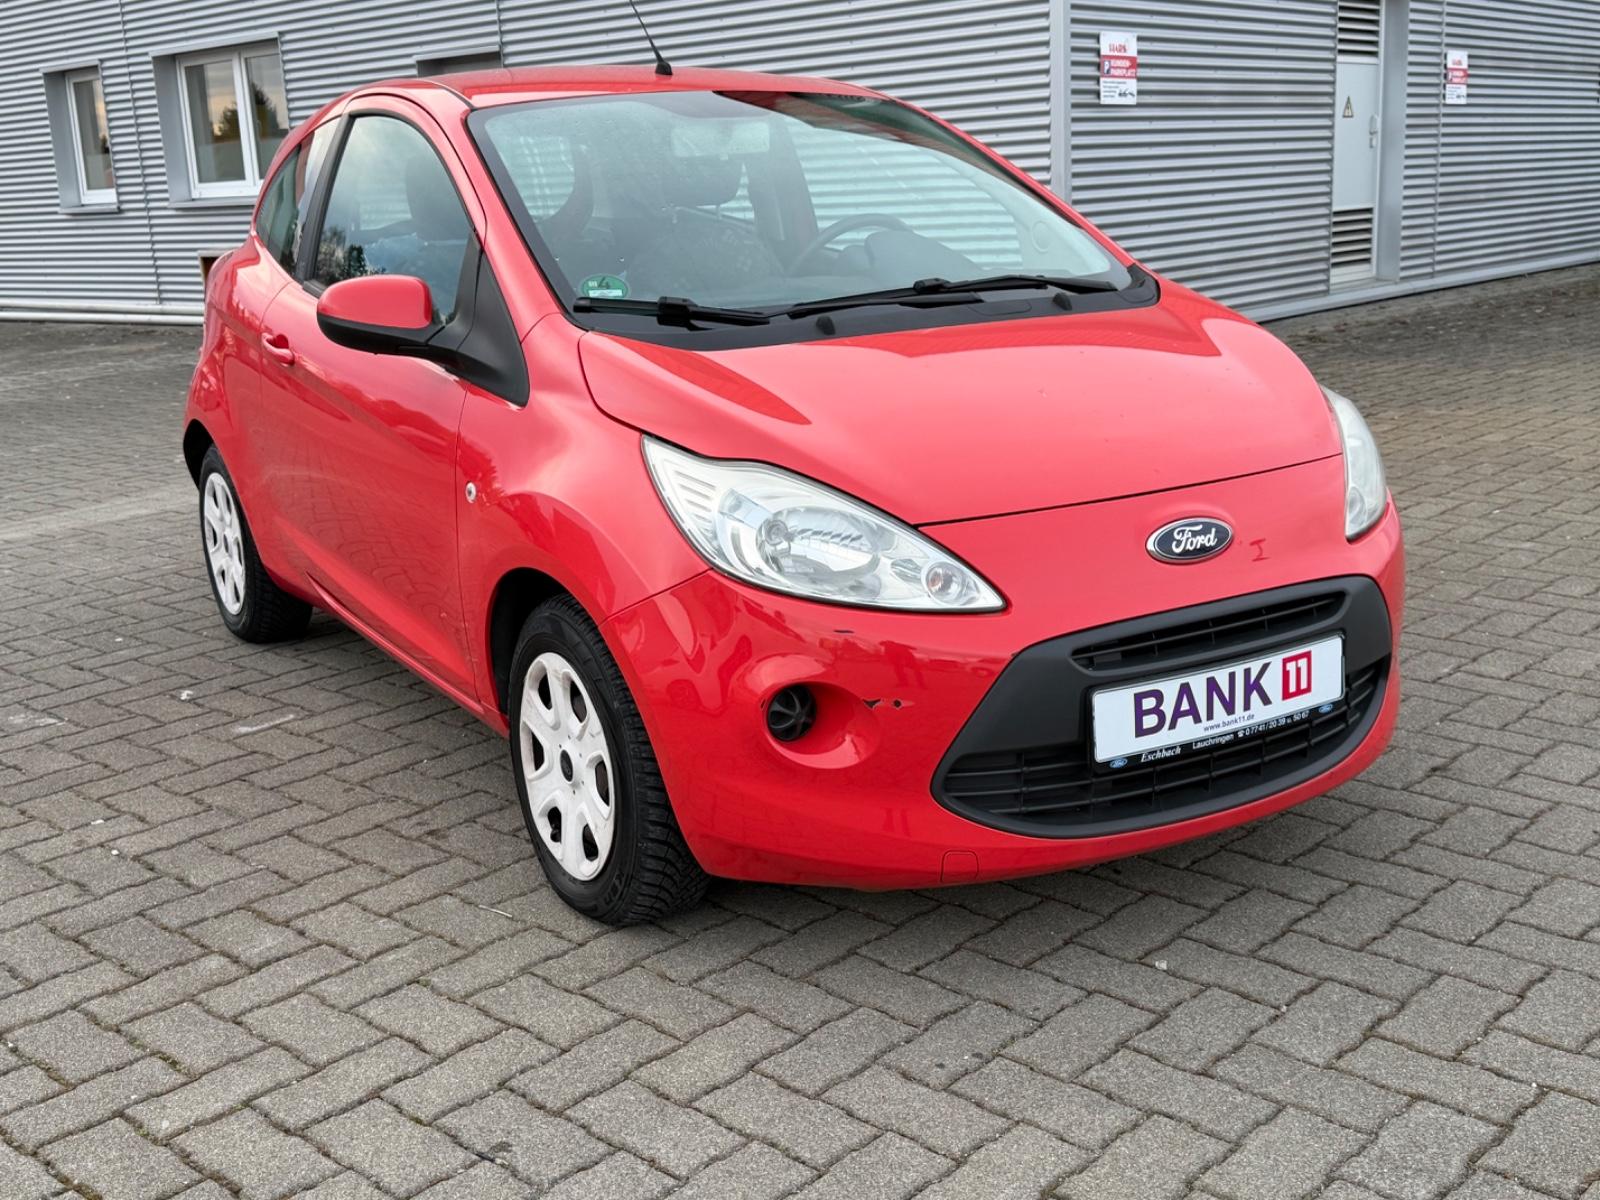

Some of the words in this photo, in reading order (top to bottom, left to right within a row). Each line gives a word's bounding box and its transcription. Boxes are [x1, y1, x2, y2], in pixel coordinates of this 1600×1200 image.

[1171, 524, 1218, 554] Ford
[1133, 661, 1273, 739] BANK
[1284, 654, 1311, 696] 11
[1203, 713, 1256, 732] www.bank11.de
[1192, 733, 1235, 750] Lauchringen
[1140, 746, 1182, 763] Eschbach
